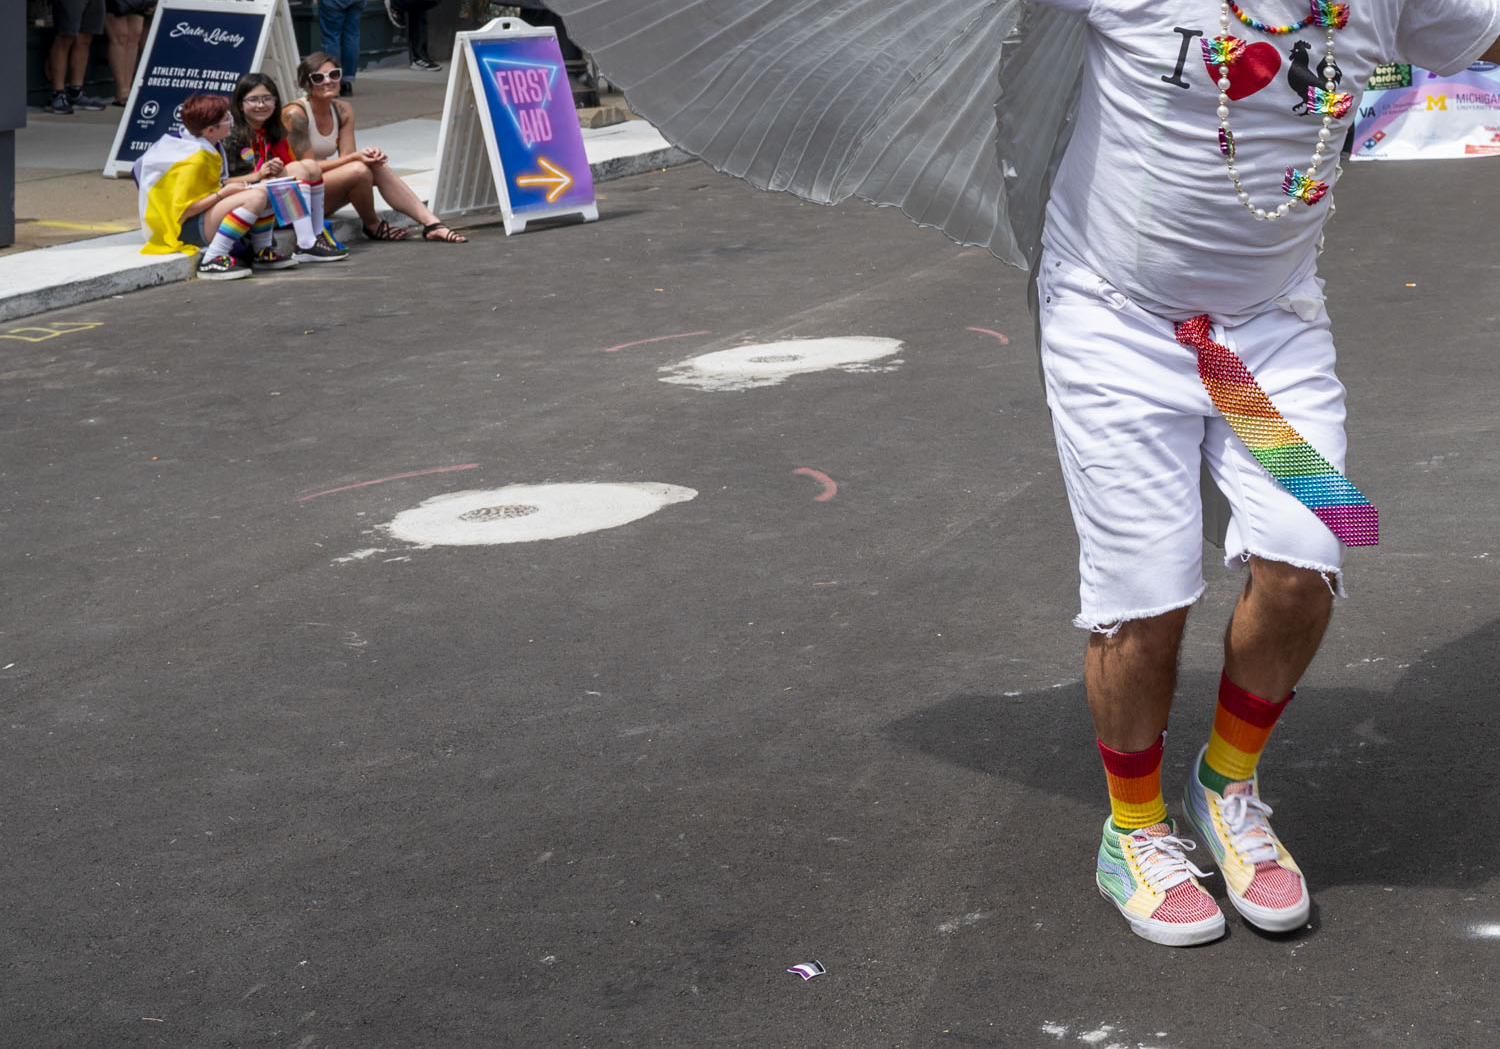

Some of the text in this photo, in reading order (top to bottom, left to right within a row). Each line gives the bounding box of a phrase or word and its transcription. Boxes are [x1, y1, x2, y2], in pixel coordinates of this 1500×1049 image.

[169, 21, 203, 38] State
[204, 28, 245, 48] Liberty
[1160, 26, 1204, 90] I
[147, 77, 170, 87] DRESS
[171, 78, 203, 89] CLOTHES
[204, 79, 220, 91] FOR
[151, 66, 240, 81] ATHLETIC FIT, STRETCHY
[1369, 72, 1402, 86] garden
[495, 68, 553, 106] FIRST
[1359, 106, 1377, 119] VA
[518, 108, 553, 144] AID
